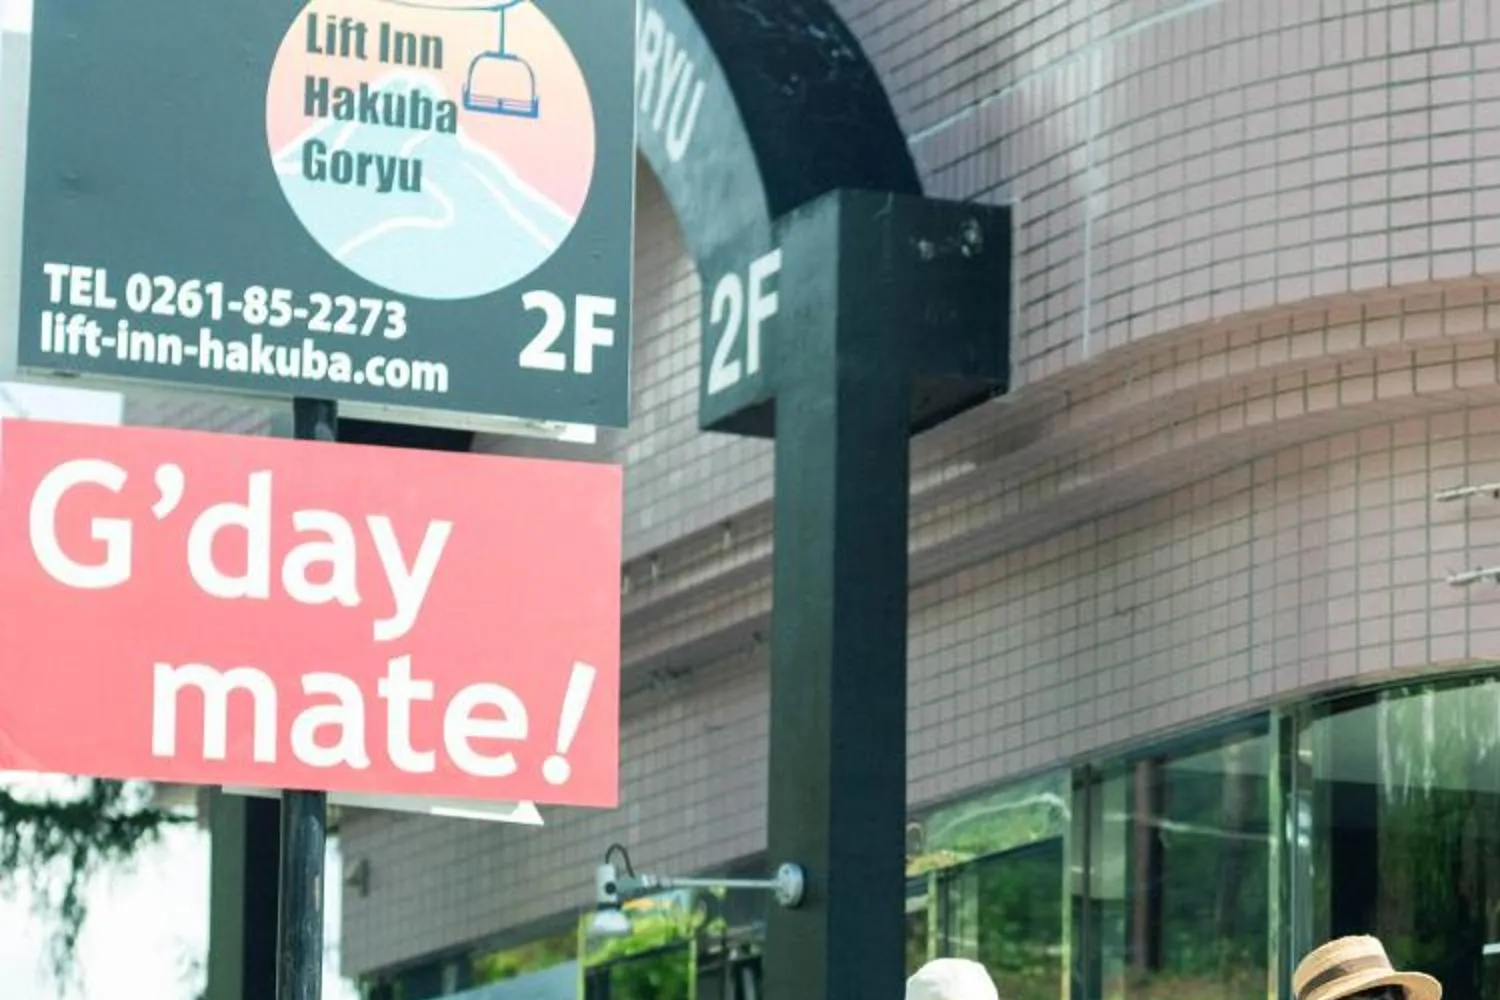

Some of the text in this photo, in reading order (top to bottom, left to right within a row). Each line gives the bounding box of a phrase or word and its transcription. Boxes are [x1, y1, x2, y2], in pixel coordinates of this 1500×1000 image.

[306, 13, 443, 69] Lift Inn
[304, 76, 457, 134] Hakuba
[302, 139, 423, 193] Goryu
[43, 263, 408, 340] TEL 0261-85-2273
[519, 289, 617, 375] 2F
[708, 248, 782, 395] 2F
[41, 310, 449, 393] lift-inn-hakuba.com
[29, 458, 453, 642] G'day
[151, 654, 597, 786] mate!
